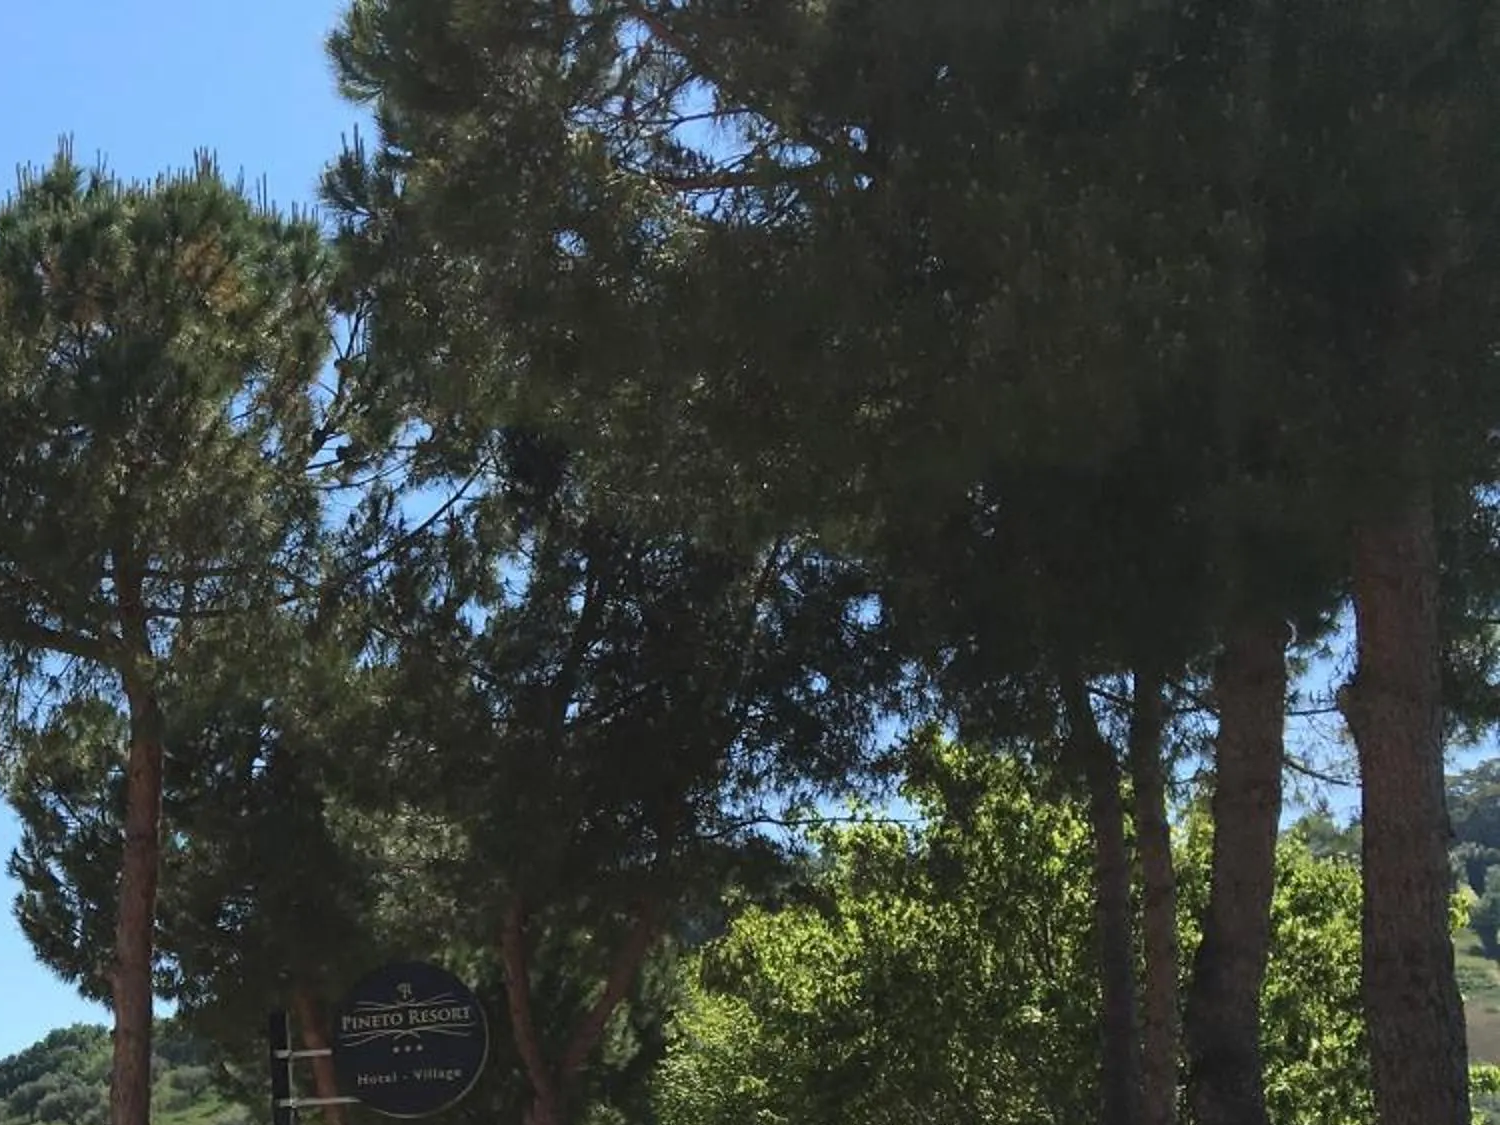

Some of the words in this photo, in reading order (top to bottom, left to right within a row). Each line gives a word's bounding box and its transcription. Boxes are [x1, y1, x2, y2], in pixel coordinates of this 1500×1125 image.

[341, 1013, 403, 1031] PINETO
[408, 1006, 471, 1025] RESORT
[357, 1070, 397, 1086] Hotel
[413, 1067, 462, 1082] Village
